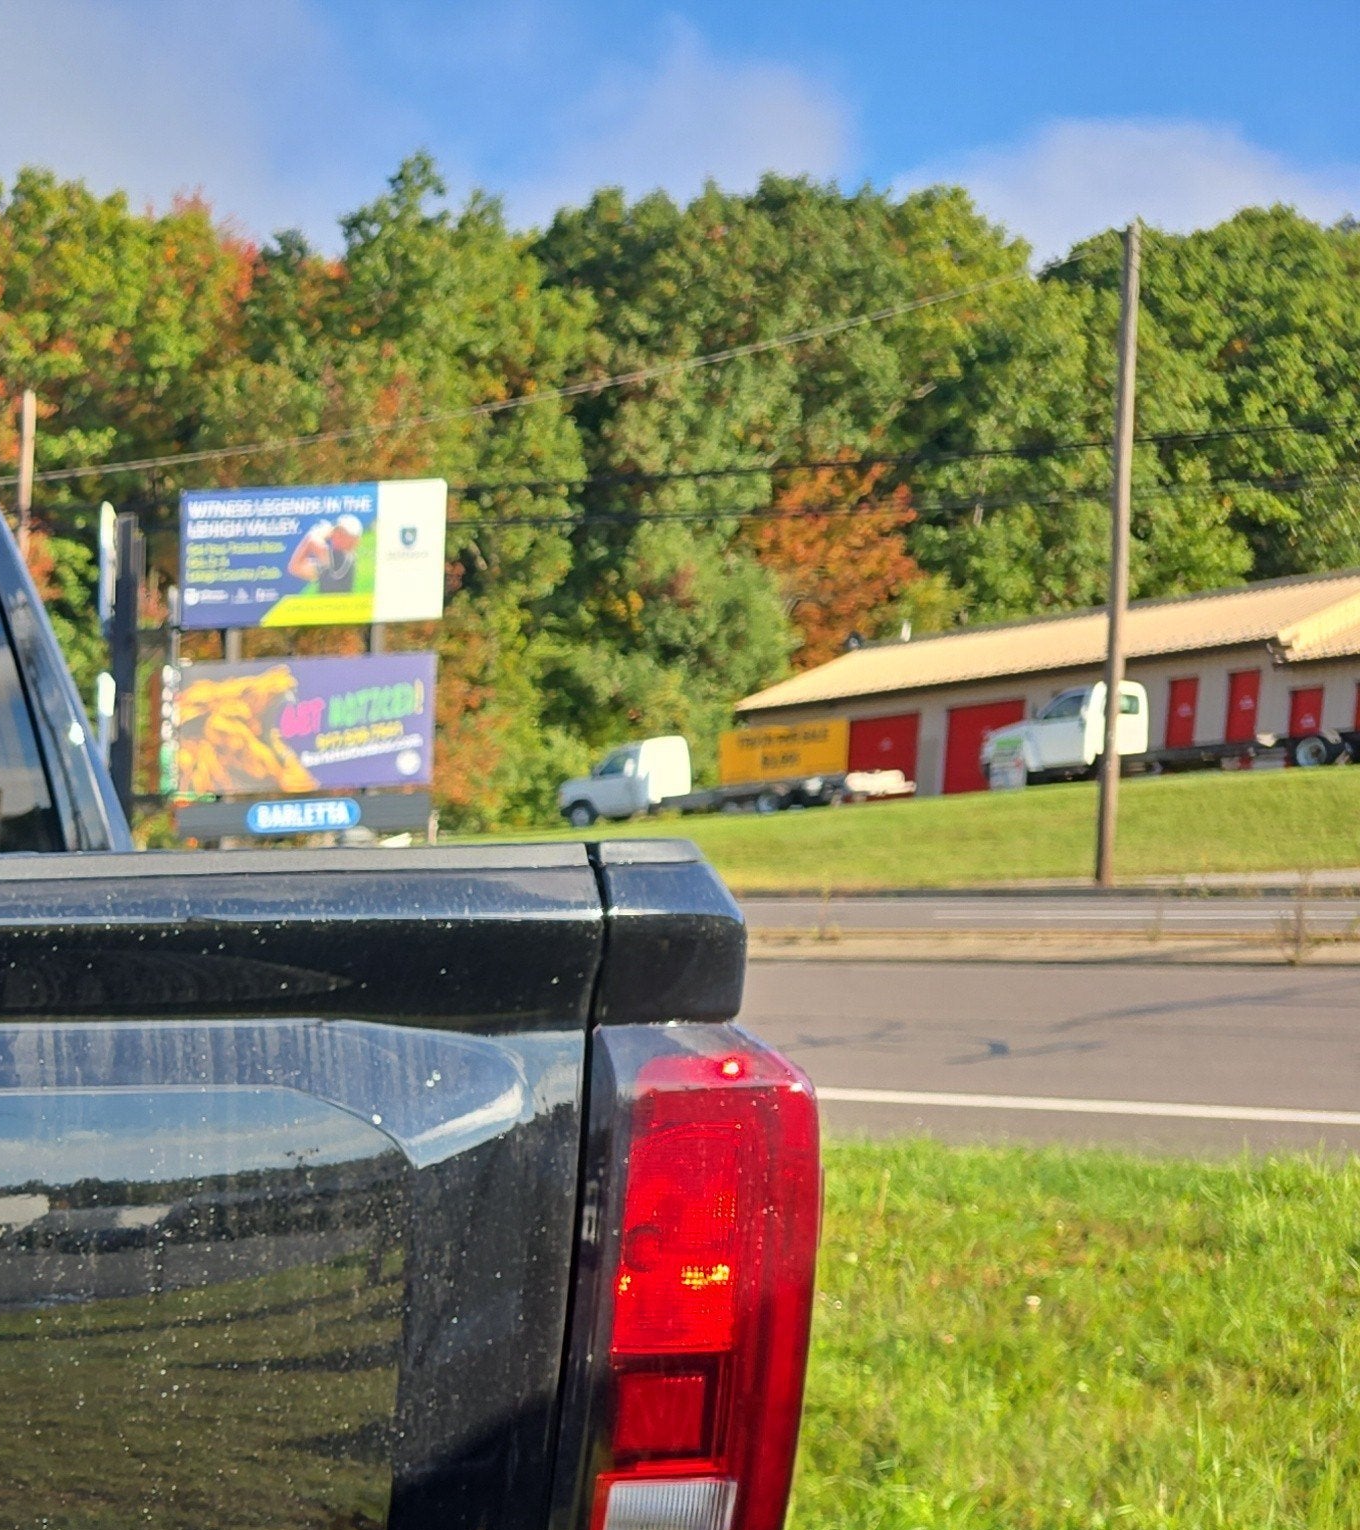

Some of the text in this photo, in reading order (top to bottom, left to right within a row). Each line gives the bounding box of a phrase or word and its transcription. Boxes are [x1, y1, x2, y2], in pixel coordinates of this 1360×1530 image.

[188, 494, 372, 518] WITNESS LEGENDS IN THE
[187, 519, 245, 539] LEHIGH
[257, 801, 350, 829] BARLETTA
